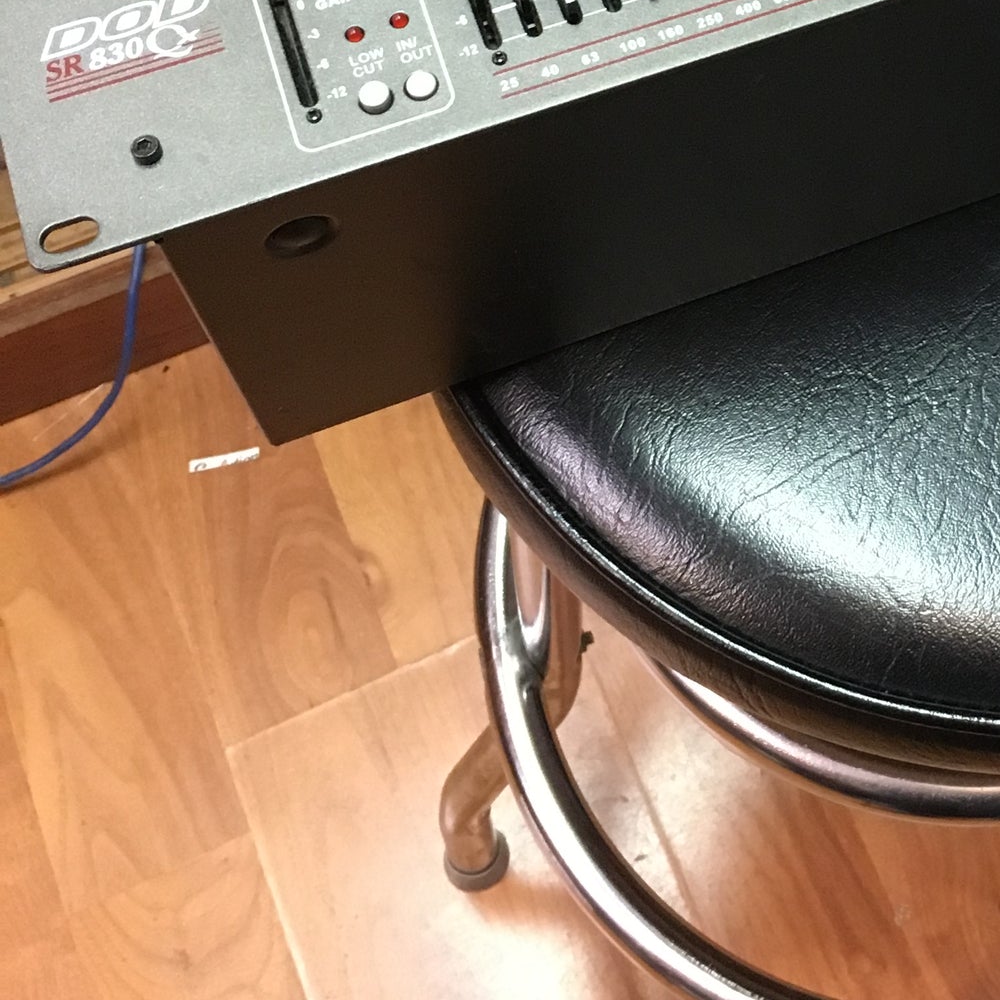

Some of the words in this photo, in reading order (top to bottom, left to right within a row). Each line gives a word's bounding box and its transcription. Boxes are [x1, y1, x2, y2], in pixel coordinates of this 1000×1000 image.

[296, 0, 305, 10] 0
[396, 36, 417, 52] IN/
[459, 44, 479, 56] -12
[500, 77, 519, 92] 25
[541, 64, 559, 77] 40
[581, 51, 600, 65] 63
[619, 37, 646, 52] 100
[658, 25, 684, 40] 160
[696, 12, 723, 29] 250
[736, 0, 761, 15] 400
[349, 47, 384, 67] LOW
[400, 44, 432, 63] OUT
[46, 54, 84, 82] SR
[352, 59, 384, 77] CUT
[327, 86, 347, 99] -12
